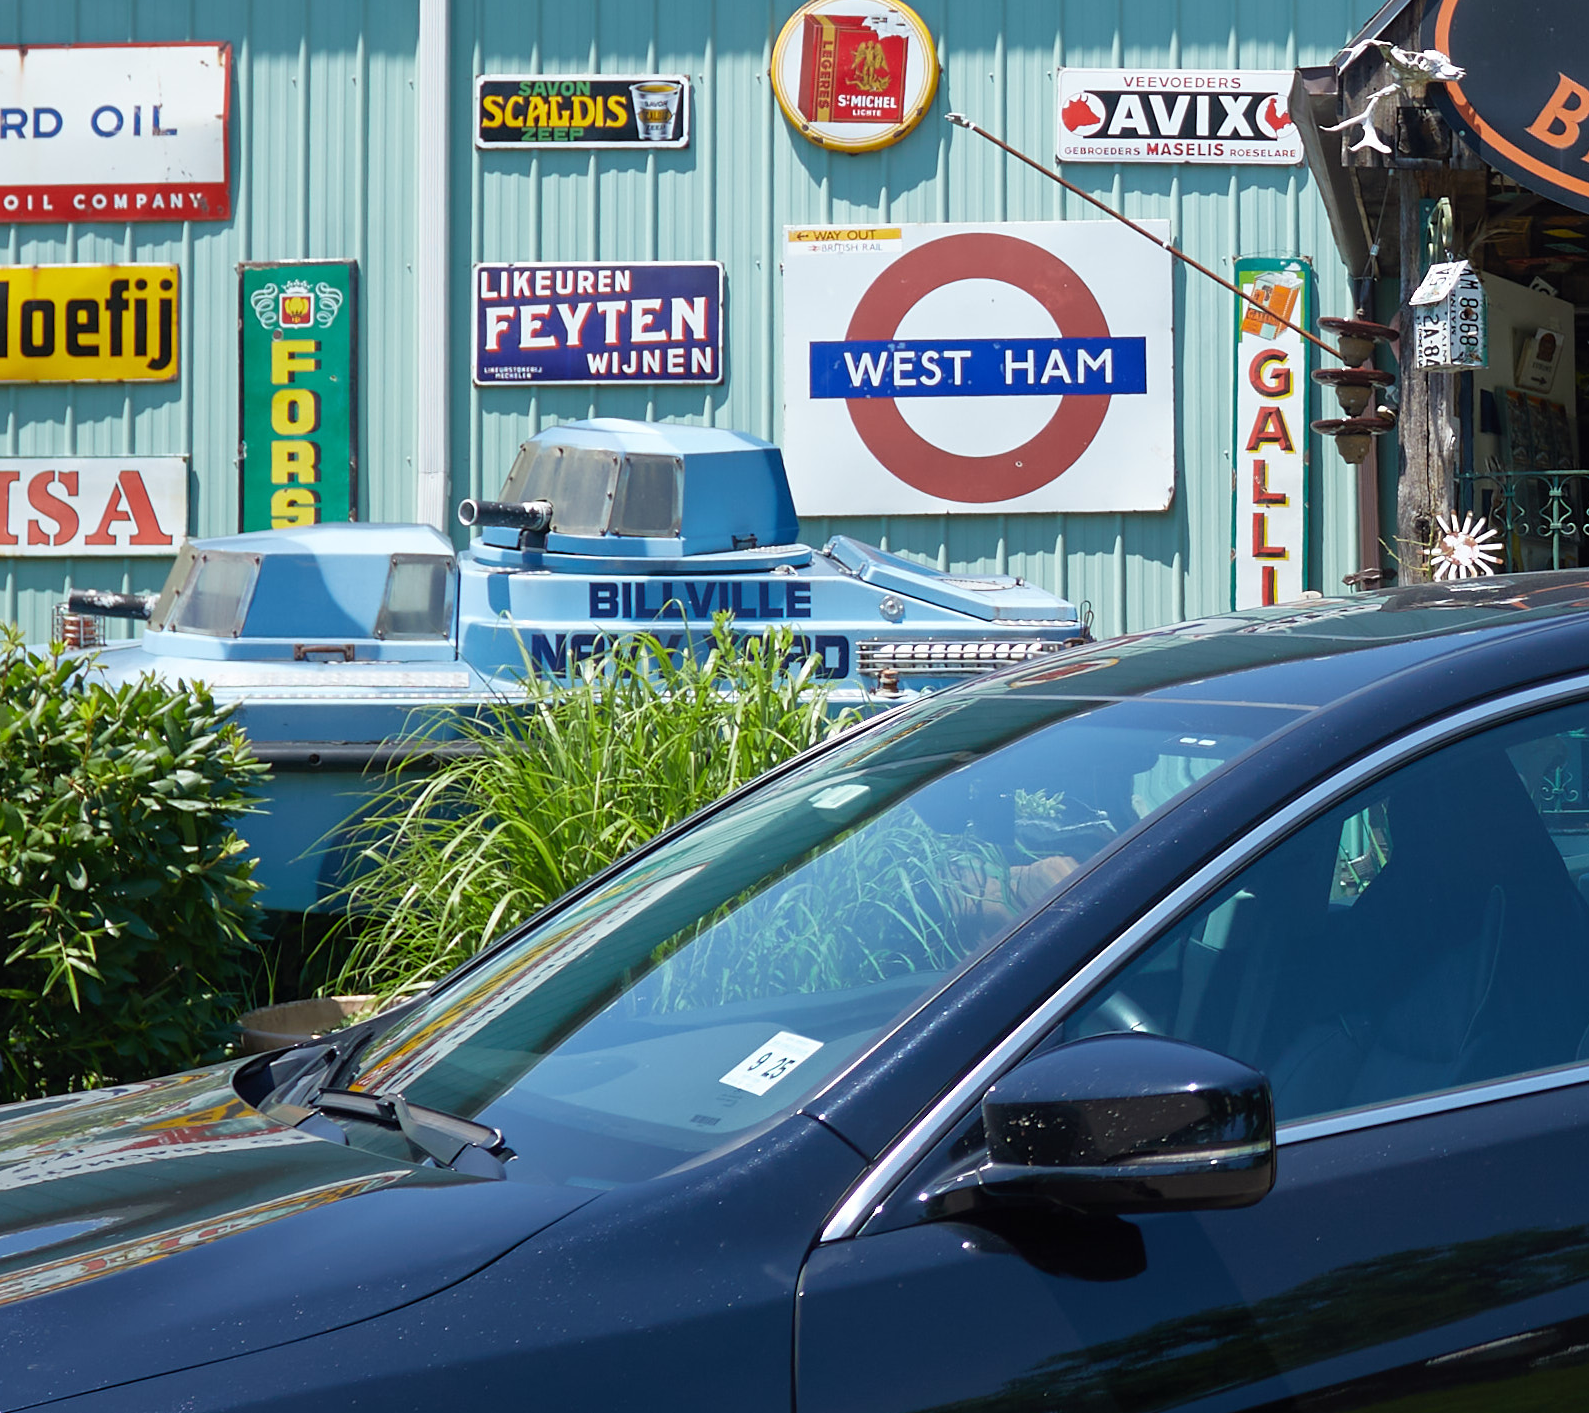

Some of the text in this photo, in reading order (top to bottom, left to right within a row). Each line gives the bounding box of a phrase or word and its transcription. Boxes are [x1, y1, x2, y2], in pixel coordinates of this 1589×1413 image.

[518, 81, 591, 97] SAVON
[818, 40, 833, 109] LEGERES
[1123, 76, 1242, 89] VEEVOEDERS
[481, 95, 629, 128] SCALDIS
[851, 95, 898, 109] MICHEL
[852, 109, 883, 117] LICHTE
[1107, 94, 1255, 137] AVIX
[90, 103, 178, 137] OIL
[521, 127, 584, 142] ZEEP
[1064, 142, 1296, 158] GEBROEDERS MASELIS ROESELARE
[3, 193, 54, 211] OIL
[73, 191, 203, 210] COMPANY
[813, 229, 877, 242] WAY OUT
[821, 243, 884, 253] BRITISH RAIL
[480, 269, 635, 300] LIKEUREN
[484, 296, 710, 353] FEYTEN
[586, 345, 715, 376] WIJNEN
[843, 346, 1115, 388] WEST HAM
[270, 338, 322, 531] FORS
[589, 582, 811, 620] BILLVILLE
[747, 1052, 796, 1080] 9 25
